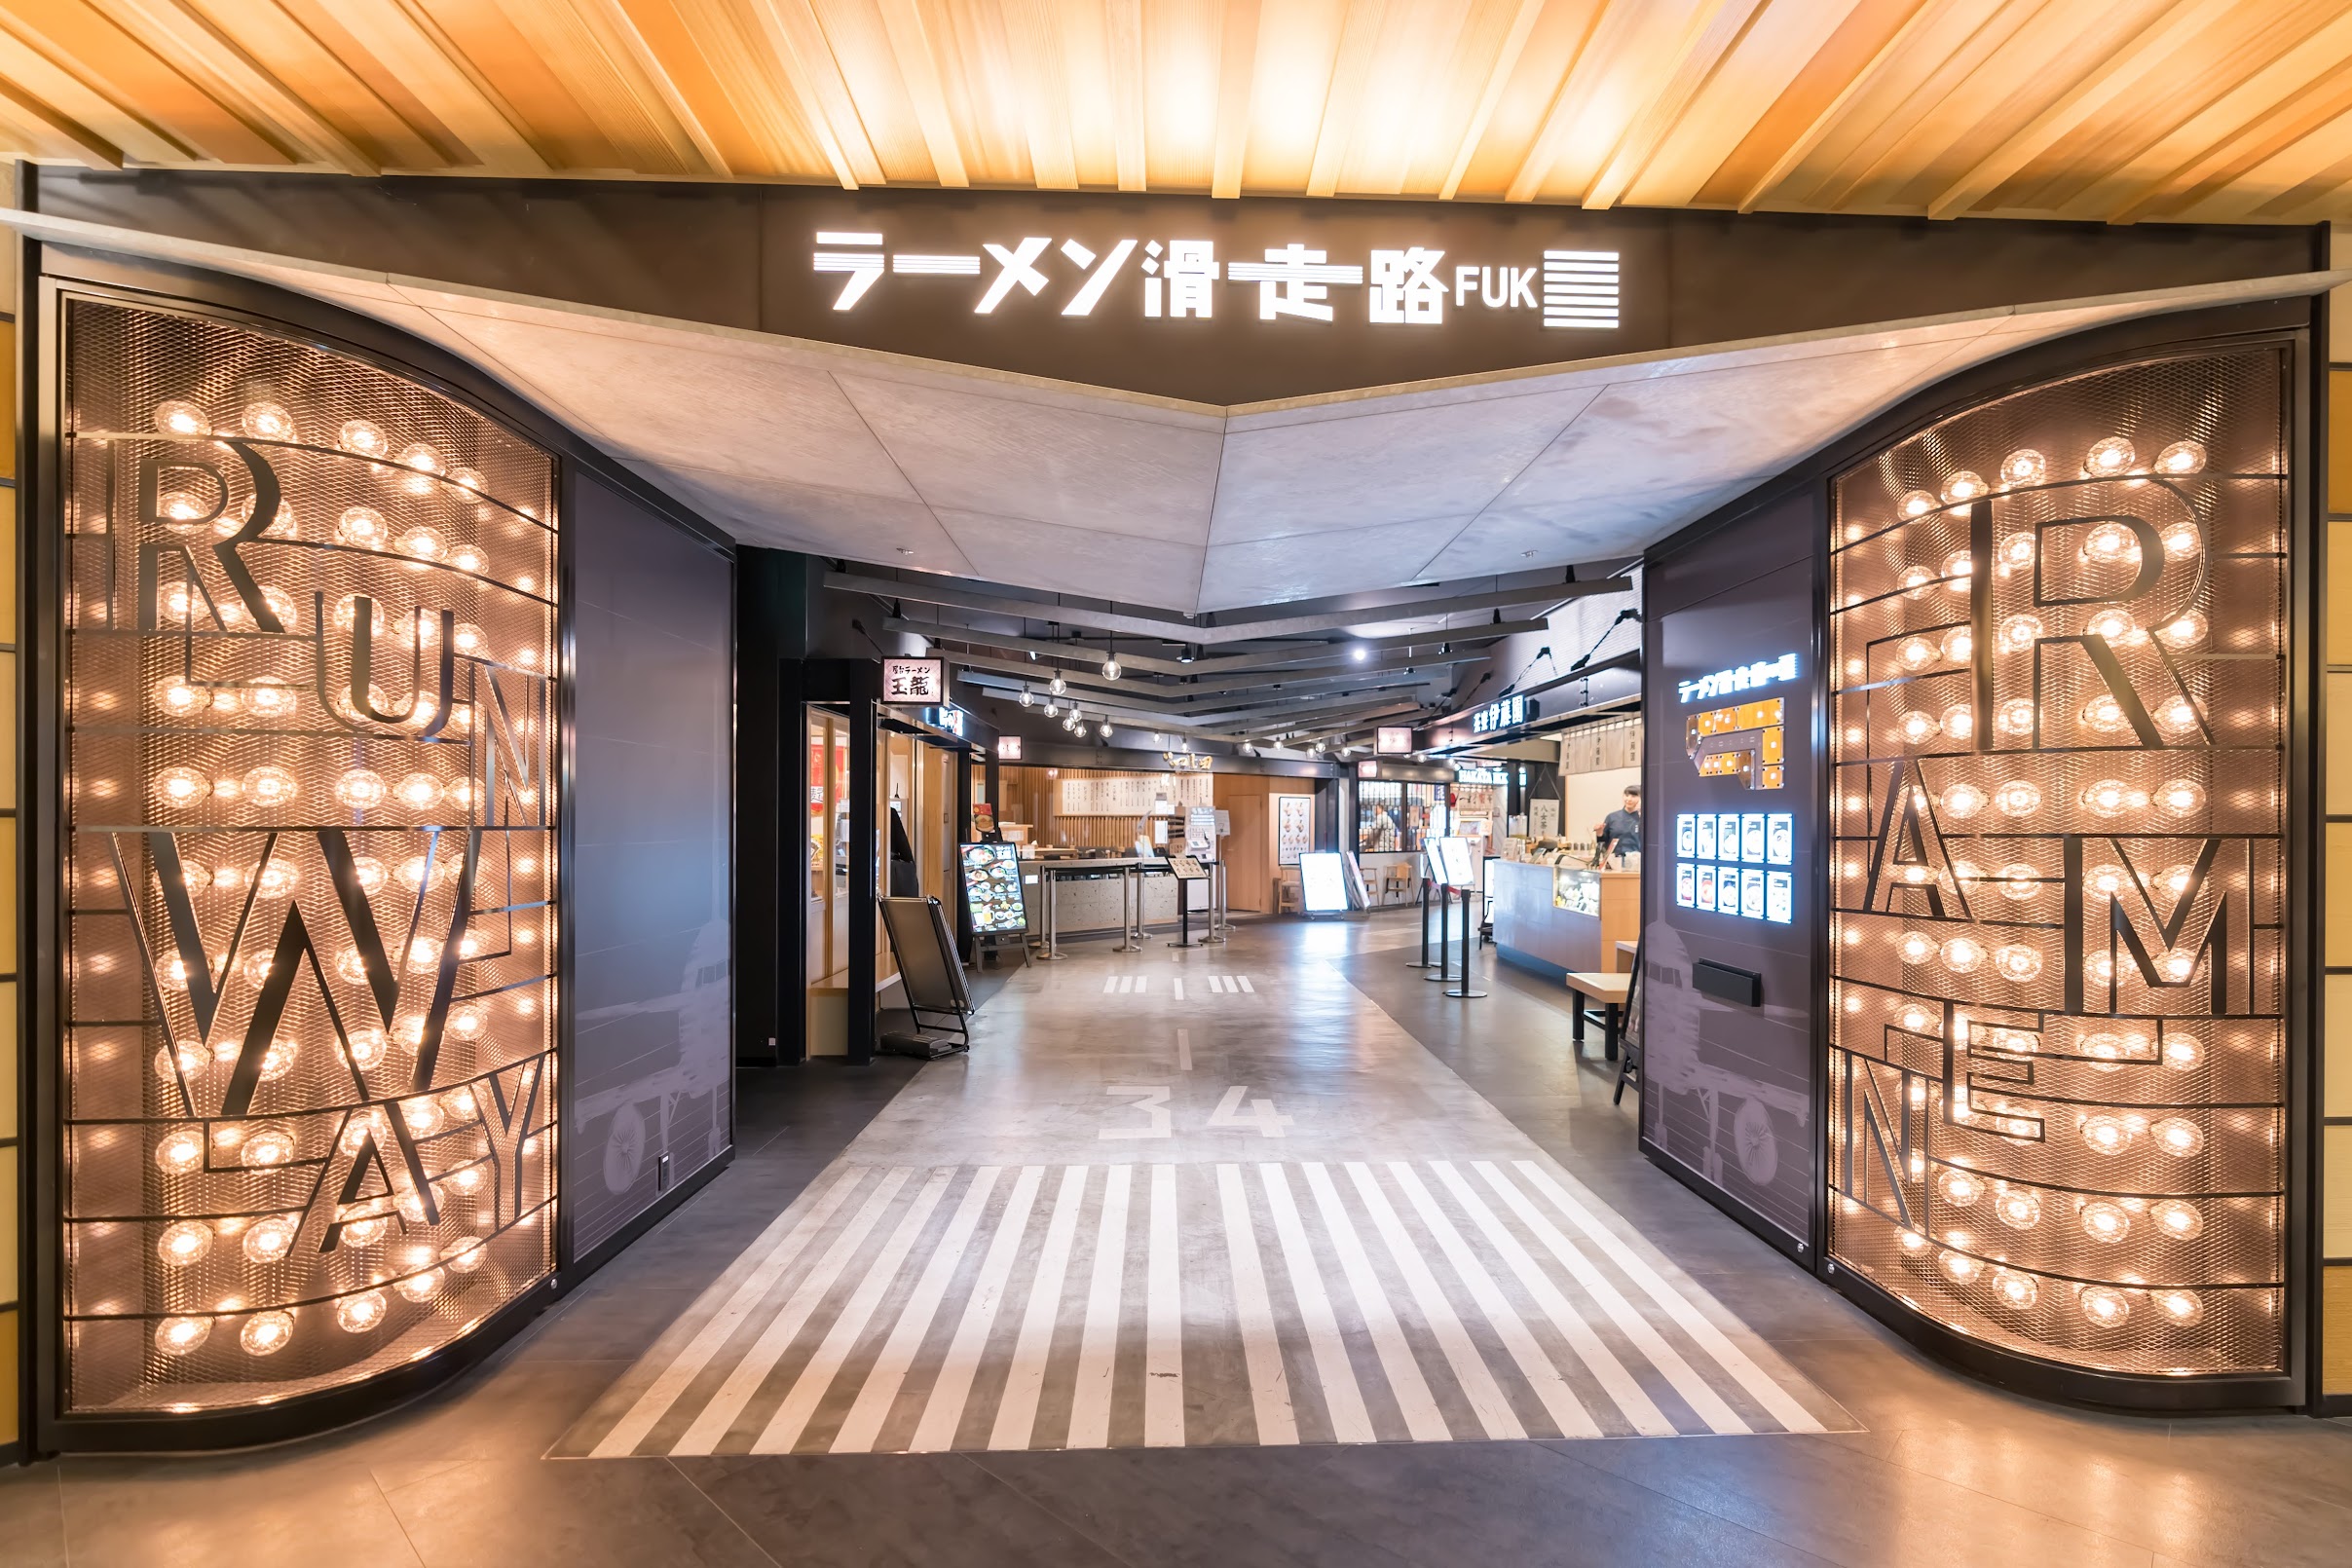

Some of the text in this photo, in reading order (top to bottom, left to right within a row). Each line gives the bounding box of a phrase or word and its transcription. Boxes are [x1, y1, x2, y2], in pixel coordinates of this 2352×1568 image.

[813, 231, 1538, 324] ラーメン滑走路 FUK
